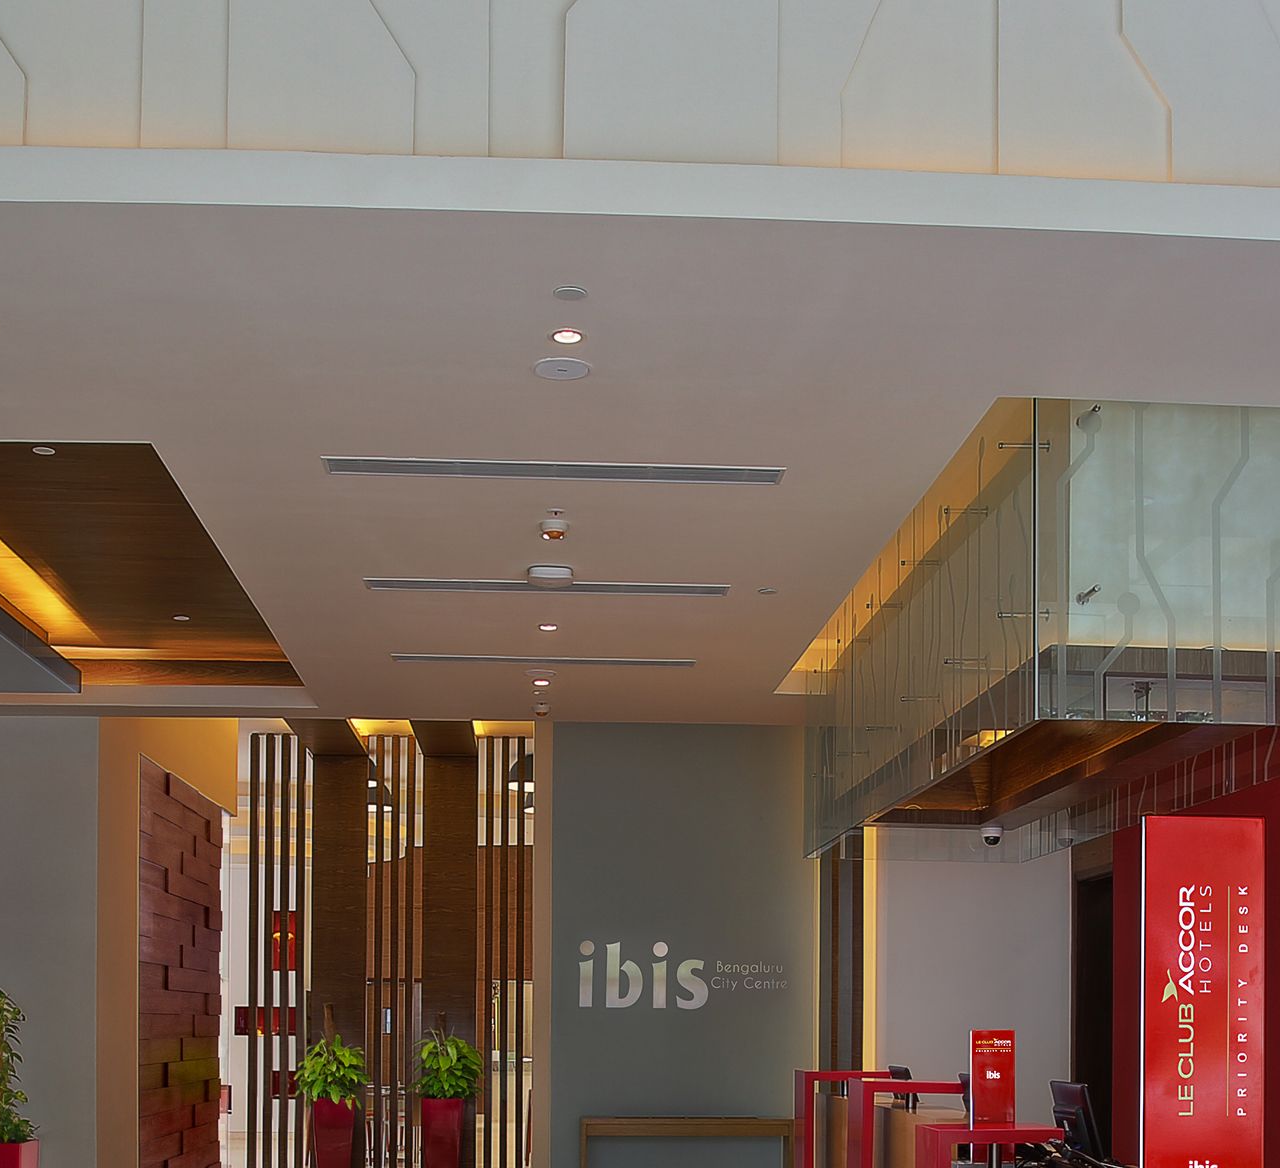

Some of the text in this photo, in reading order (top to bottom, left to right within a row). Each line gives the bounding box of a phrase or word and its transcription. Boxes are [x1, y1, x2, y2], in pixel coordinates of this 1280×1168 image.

[716, 960, 784, 975] Bengaluru
[1199, 884, 1212, 993] HOTELS
[578, 940, 709, 1010] ibis
[710, 976, 789, 992] City Centre
[1177, 884, 1195, 1117] LE CLUB ACCOR
[1236, 885, 1249, 1117] PRIORITY DESK
[986, 1070, 1001, 1080] ibis
